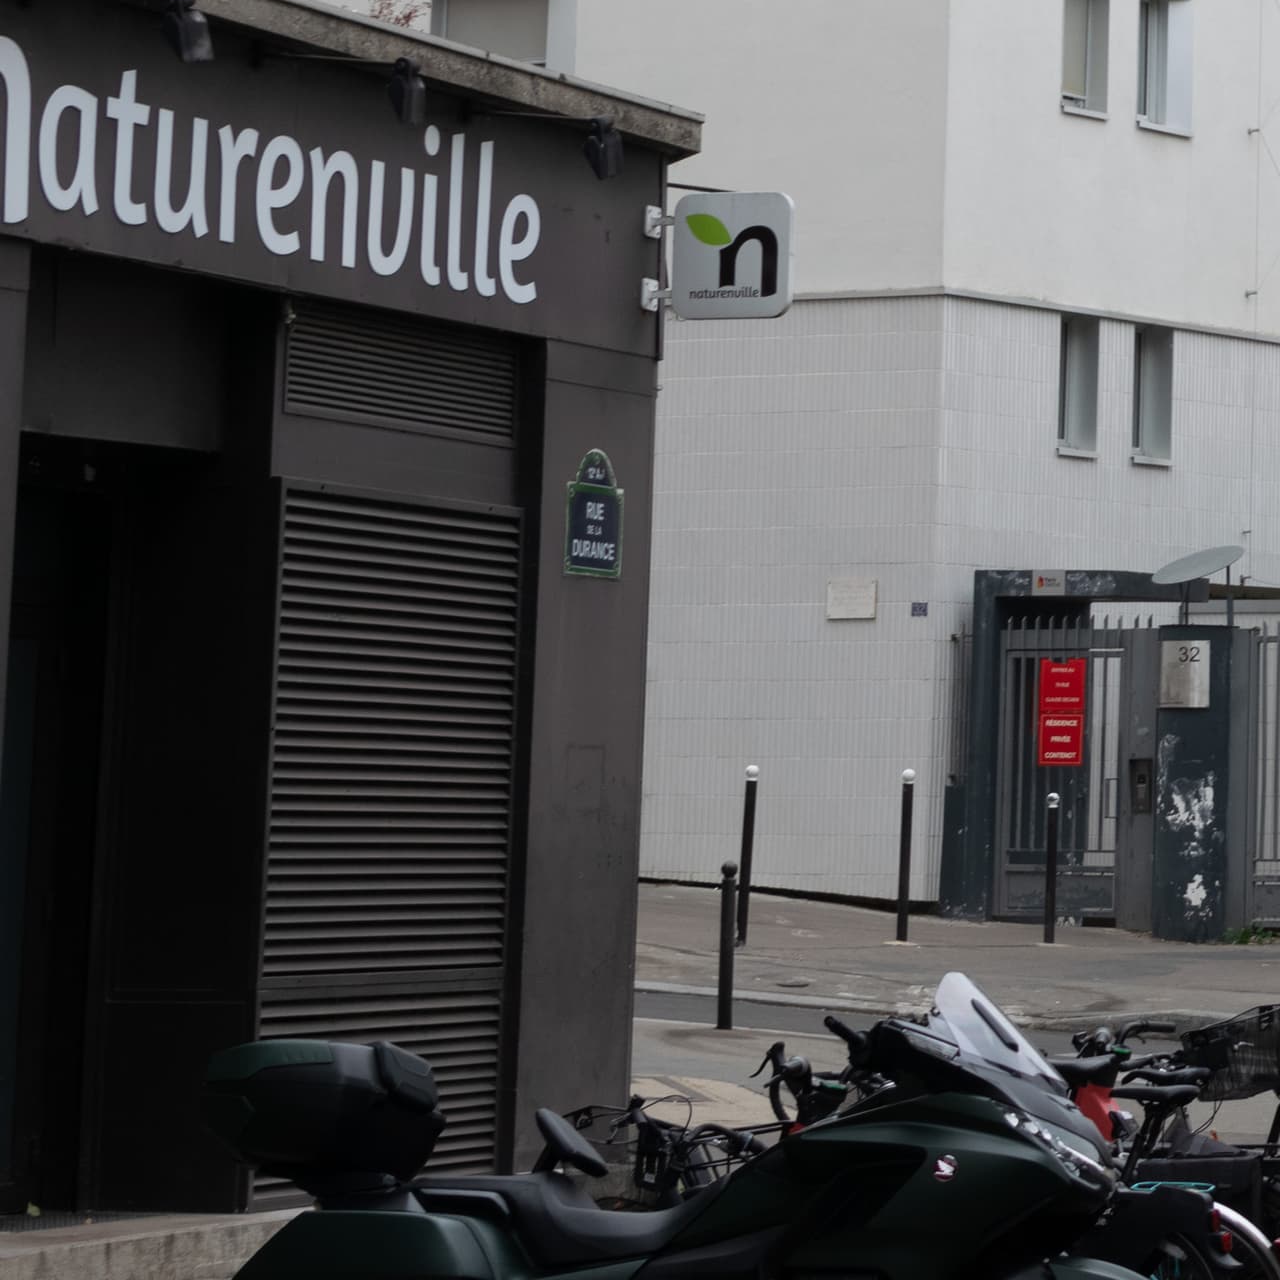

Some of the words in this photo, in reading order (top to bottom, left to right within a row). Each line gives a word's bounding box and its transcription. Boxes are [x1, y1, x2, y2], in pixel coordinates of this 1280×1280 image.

[688, 286, 760, 299] naturenville
[586, 501, 605, 520] RUE
[571, 538, 616, 561] DURANCE
[1178, 646, 1201, 663] 32
